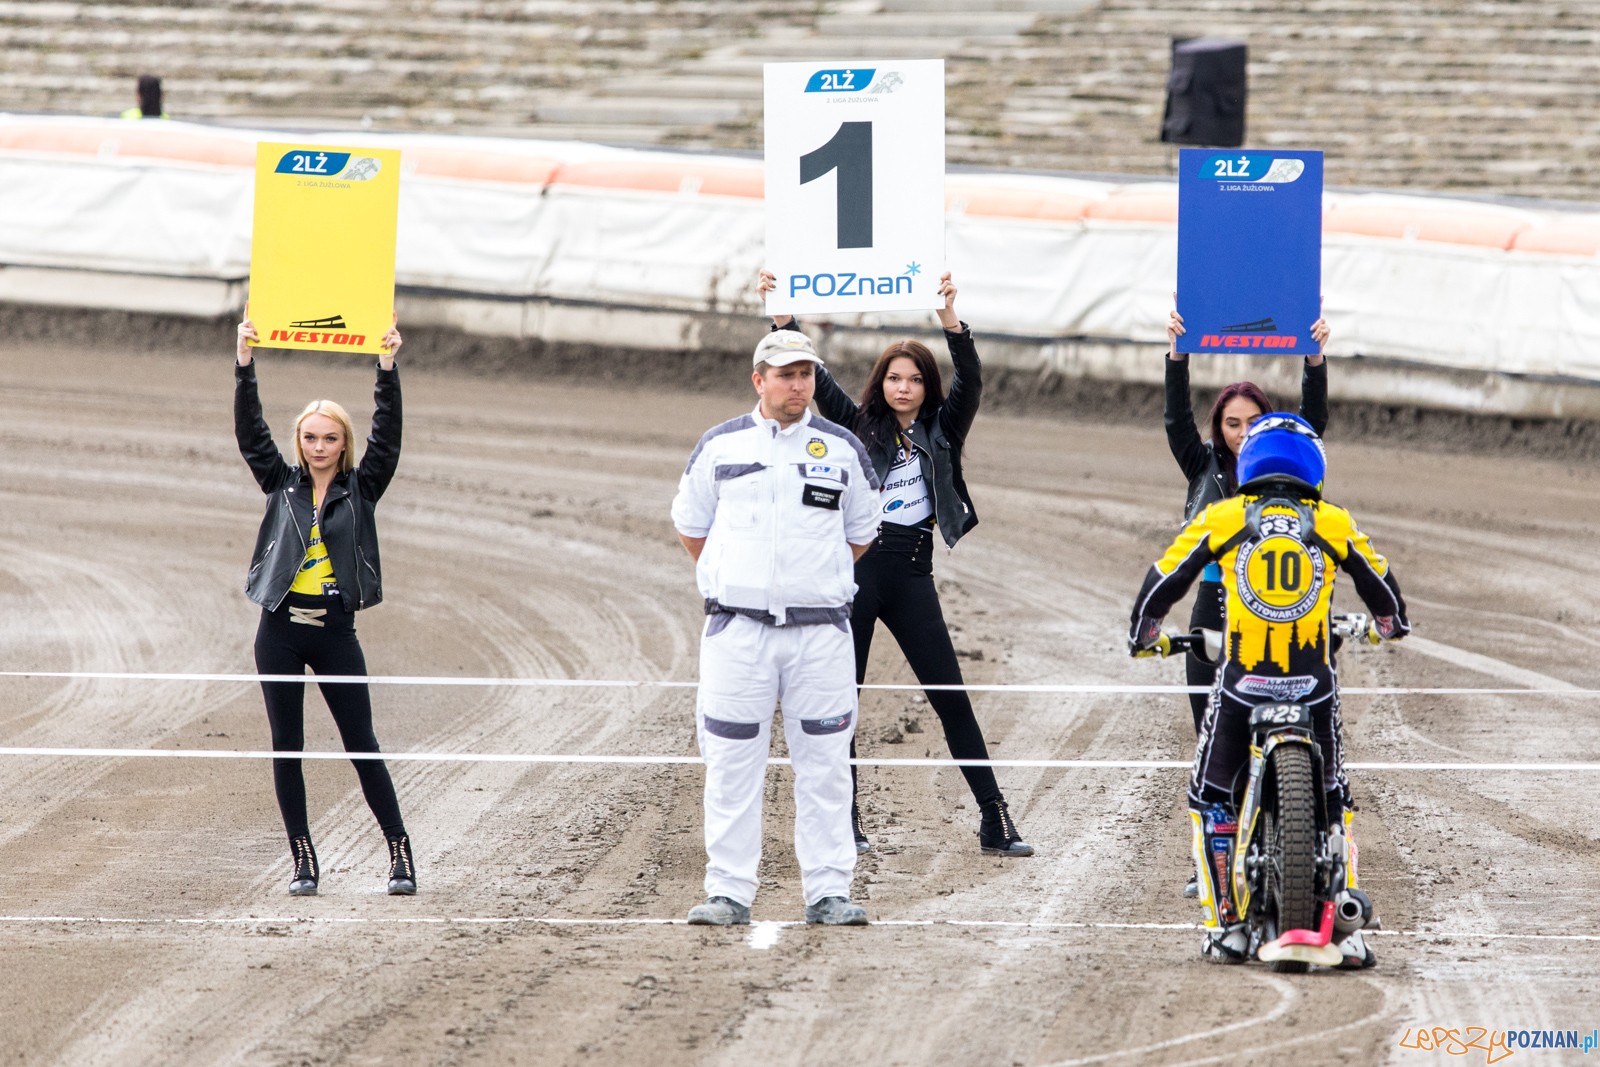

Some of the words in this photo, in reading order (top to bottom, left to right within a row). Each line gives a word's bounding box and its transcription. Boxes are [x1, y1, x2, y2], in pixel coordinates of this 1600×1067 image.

[821, 69, 855, 90] 2LŻ
[291, 152, 329, 173] 2LŻ
[1214, 156, 1251, 177] 2LŻ
[799, 121, 873, 249] 1
[270, 330, 366, 346] IVESTON
[1200, 335, 1297, 348] IVESTON
[1261, 550, 1301, 592] 10
[1261, 705, 1302, 723] #25
